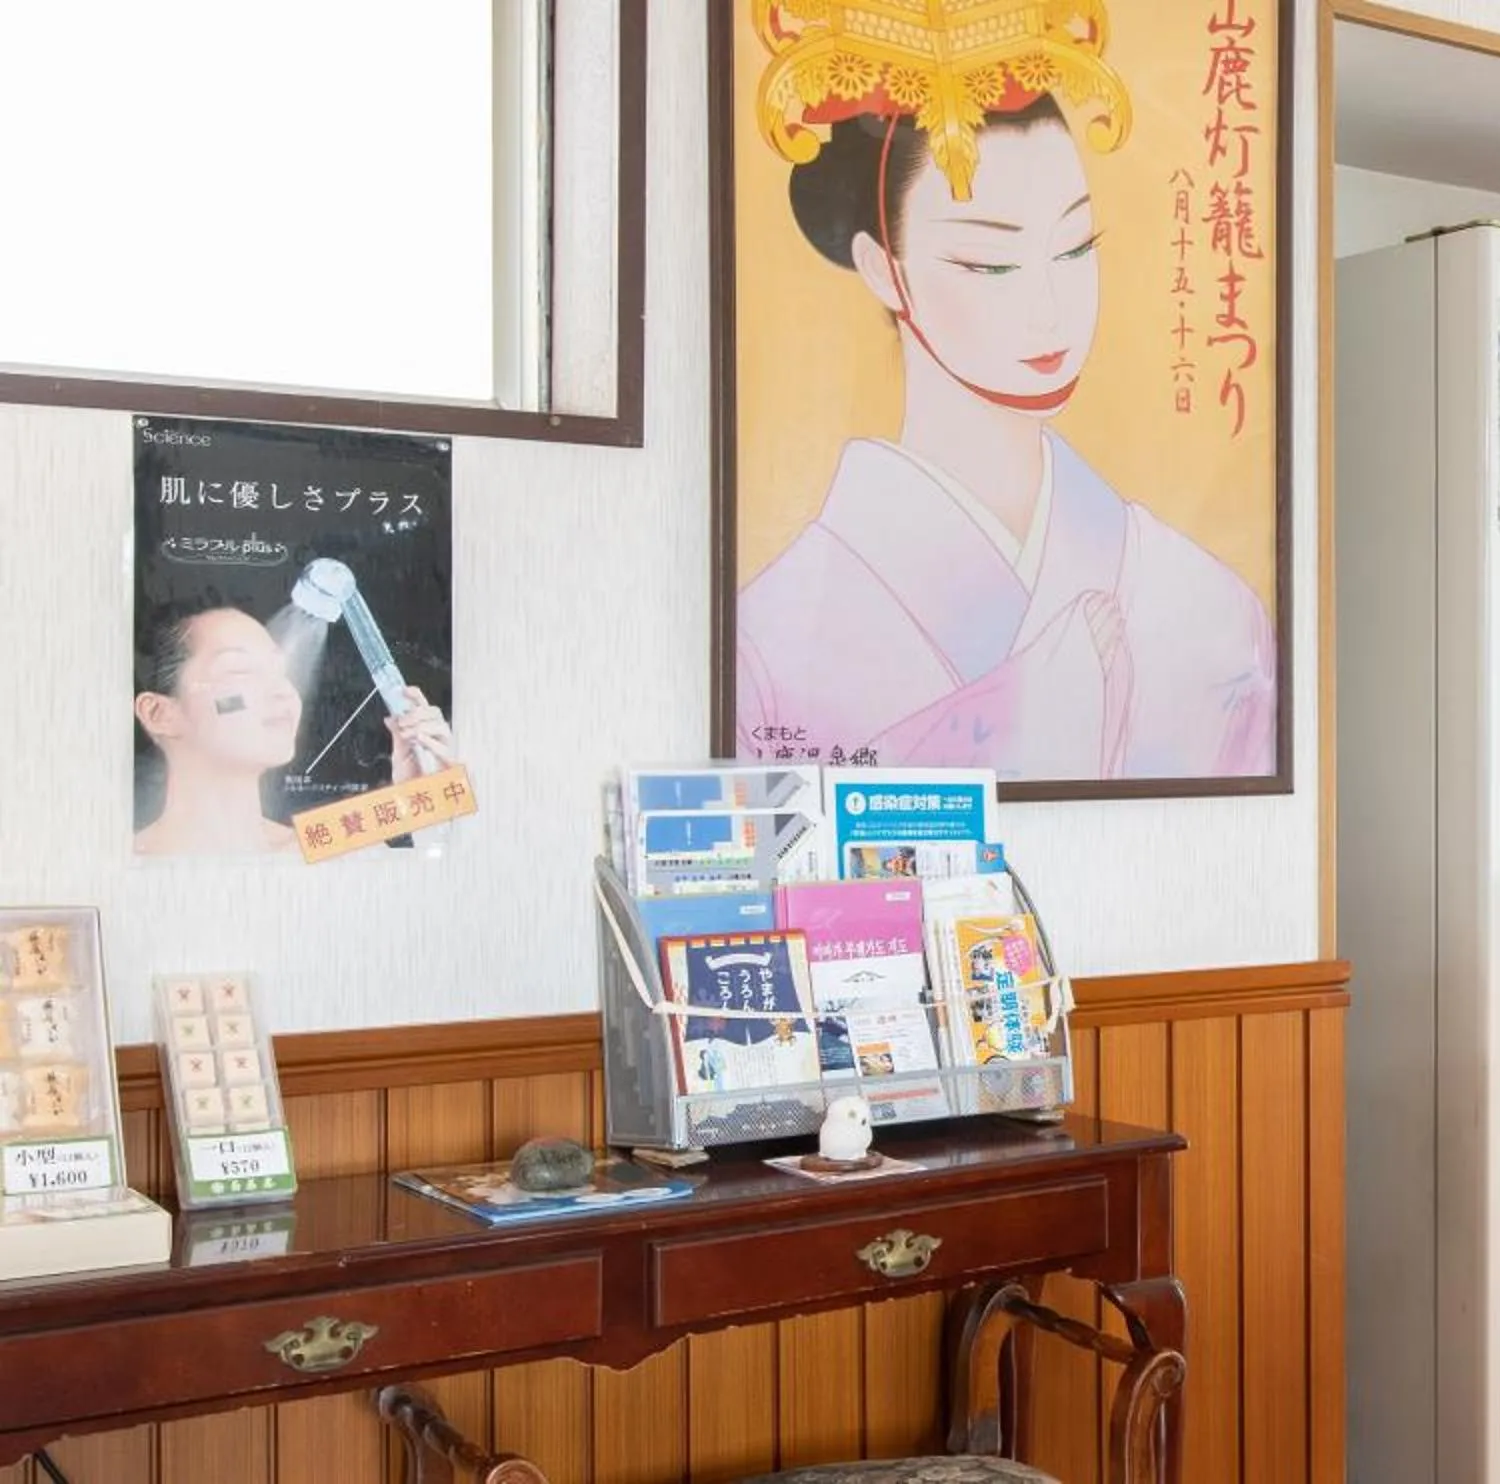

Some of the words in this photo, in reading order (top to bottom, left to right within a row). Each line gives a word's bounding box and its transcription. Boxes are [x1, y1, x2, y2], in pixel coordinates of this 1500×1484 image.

[1200, 0, 1264, 438] 山鹿灯籠まつり
[1168, 168, 1195, 413] 八月十五・十六日
[143, 428, 212, 447] Science
[159, 476, 424, 516] 肌に優しさプラス
[751, 726, 808, 742] くまもと
[304, 780, 466, 849] 絶賛販売中
[220, 1161, 260, 1176] ¥570
